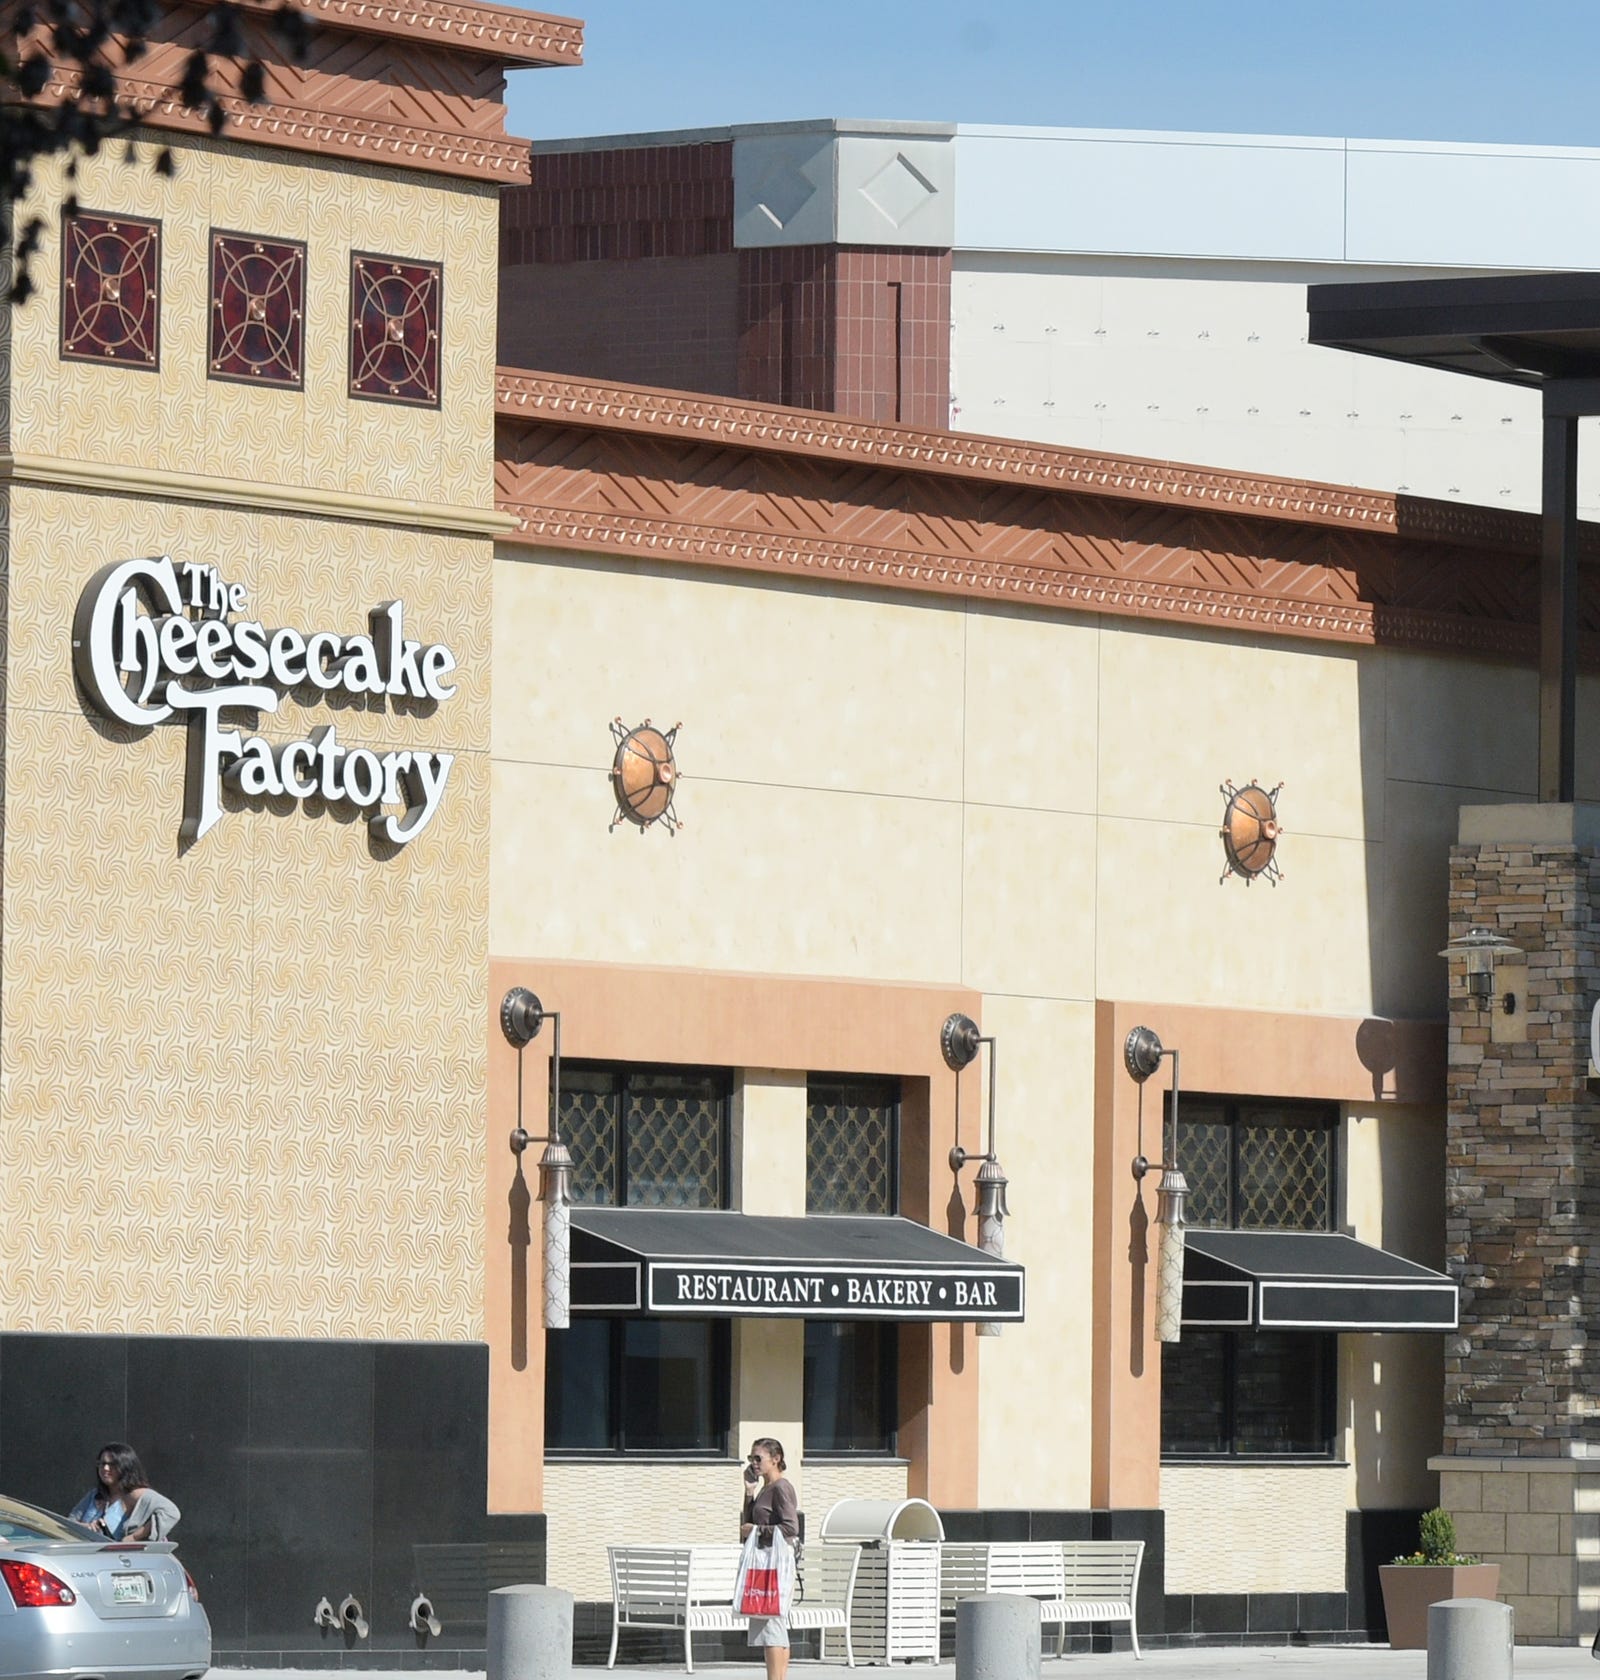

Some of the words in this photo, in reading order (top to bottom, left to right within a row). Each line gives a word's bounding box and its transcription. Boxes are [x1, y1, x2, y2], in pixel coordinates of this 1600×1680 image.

[88, 555, 457, 727] Cheesecake
[183, 561, 248, 620] The
[165, 680, 456, 845] Factory
[676, 1274, 825, 1303] RESTAURANT
[847, 1278, 934, 1305] BAKERY
[955, 1281, 998, 1306] BAR
